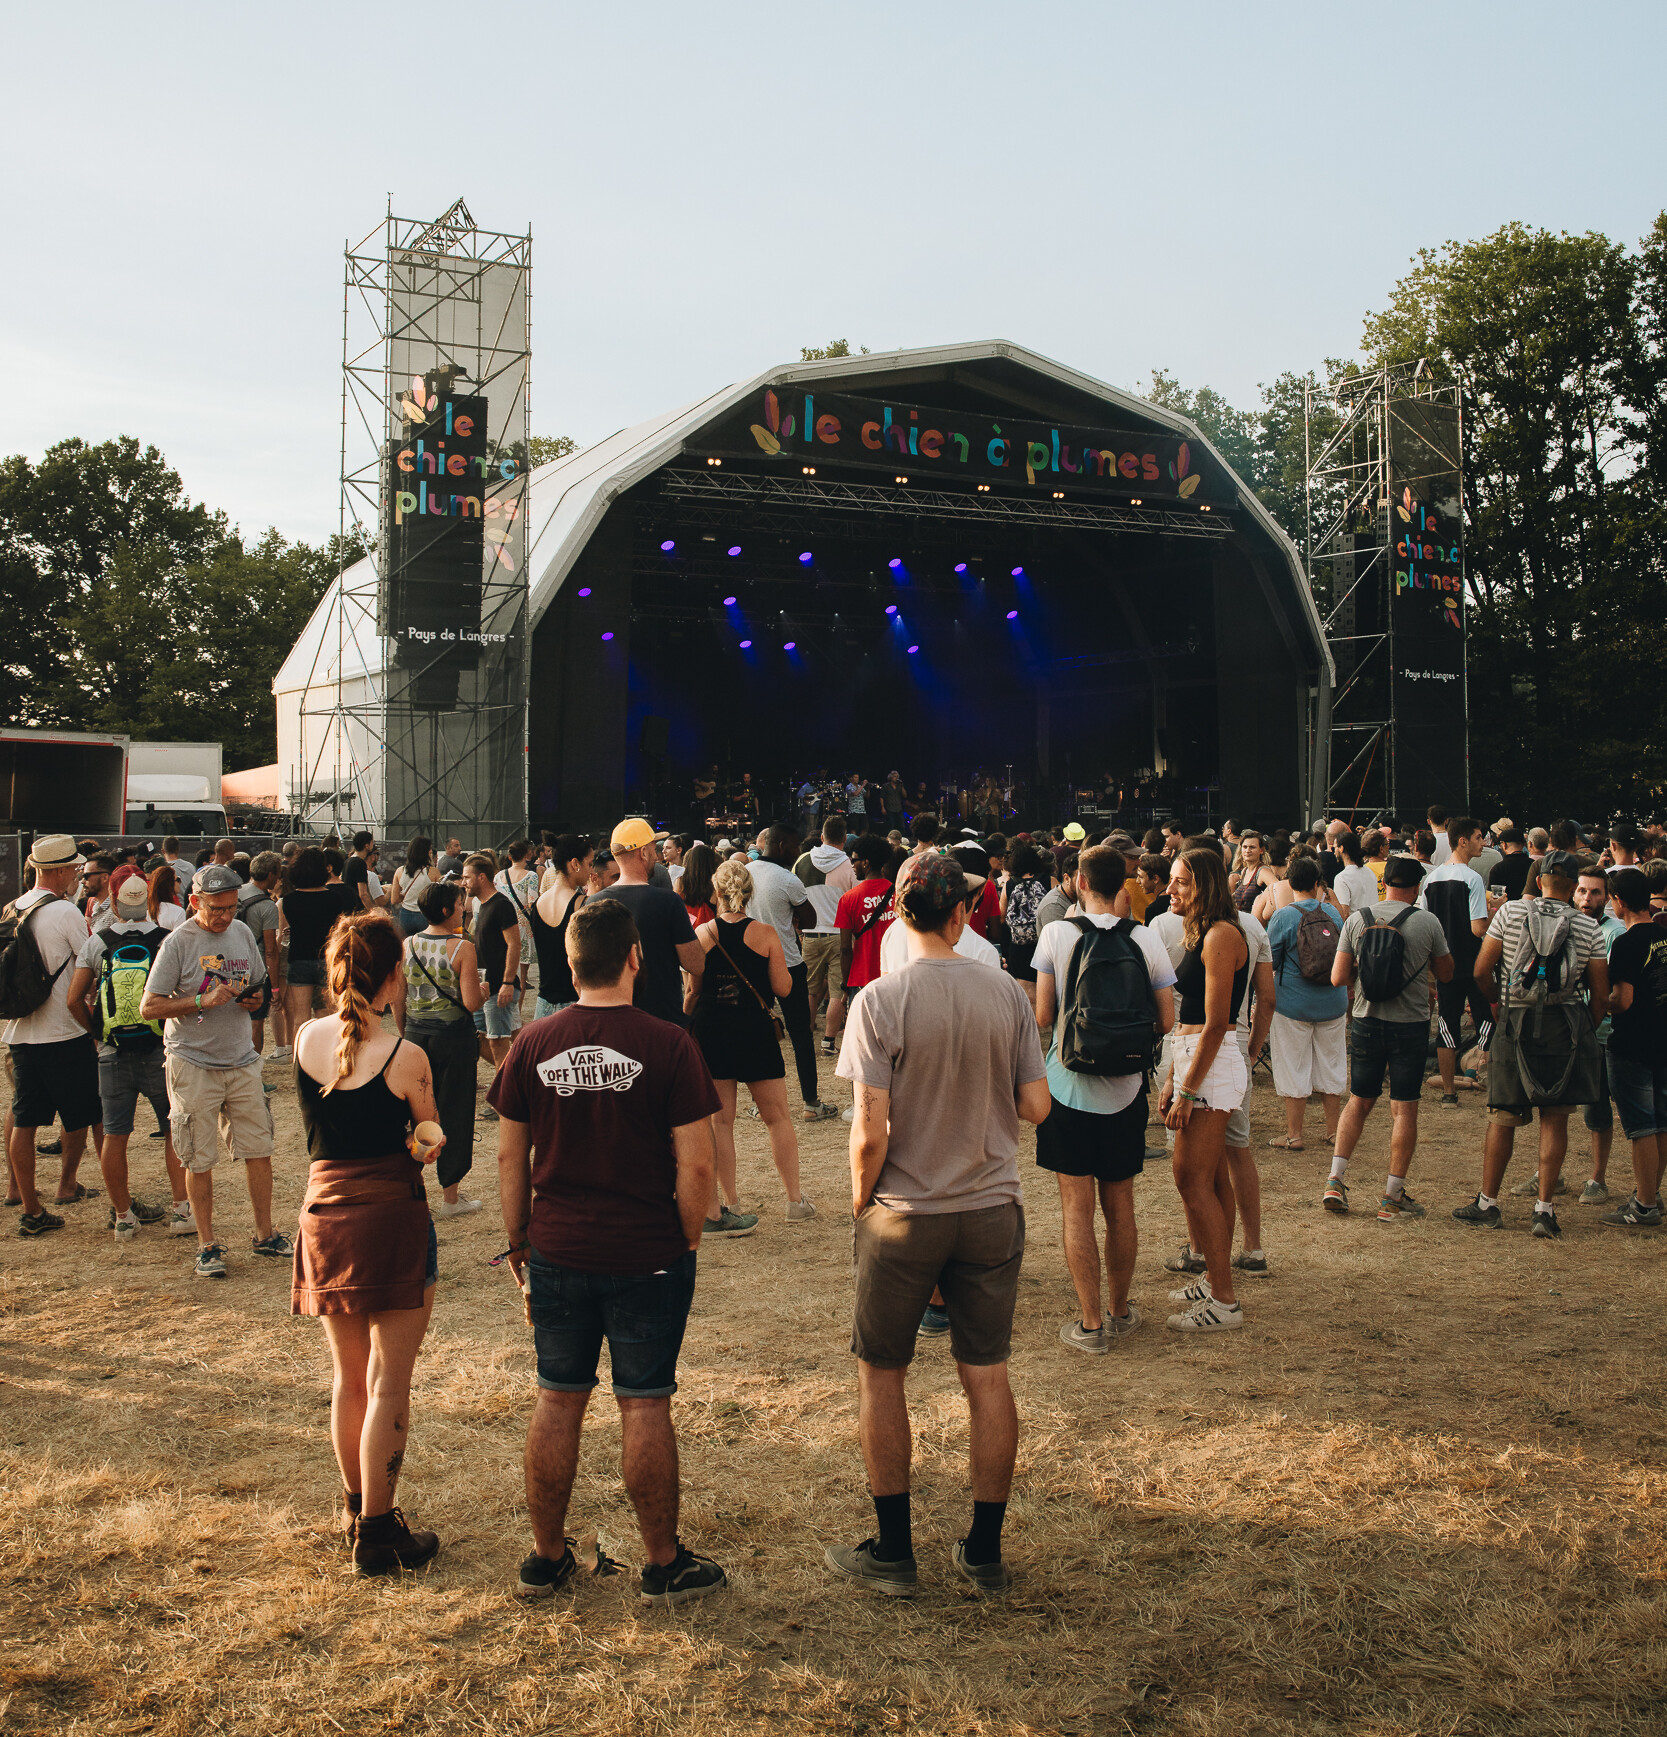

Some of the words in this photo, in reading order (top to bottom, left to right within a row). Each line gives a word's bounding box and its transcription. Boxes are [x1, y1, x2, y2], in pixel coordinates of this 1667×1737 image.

[445, 401, 475, 437] le
[804, 394, 842, 444] le
[861, 407, 970, 463] chien
[987, 424, 1011, 467] à
[1026, 429, 1160, 485] plumes
[397, 439, 488, 479] chien
[500, 448, 520, 481] à
[395, 480, 519, 525] plumes
[1420, 506, 1437, 532] le
[1397, 533, 1445, 562] chien
[1449, 539, 1461, 563] à
[1396, 563, 1460, 596] plumes
[408, 626, 437, 644] Pays
[440, 628, 456, 640] de
[460, 628, 506, 646] Langres
[1404, 668, 1421, 682] Pays
[1422, 669, 1431, 679] de
[1431, 669, 1456, 683] Langres
[567, 1048, 604, 1066] VANS
[571, 1064, 599, 1085] THE
